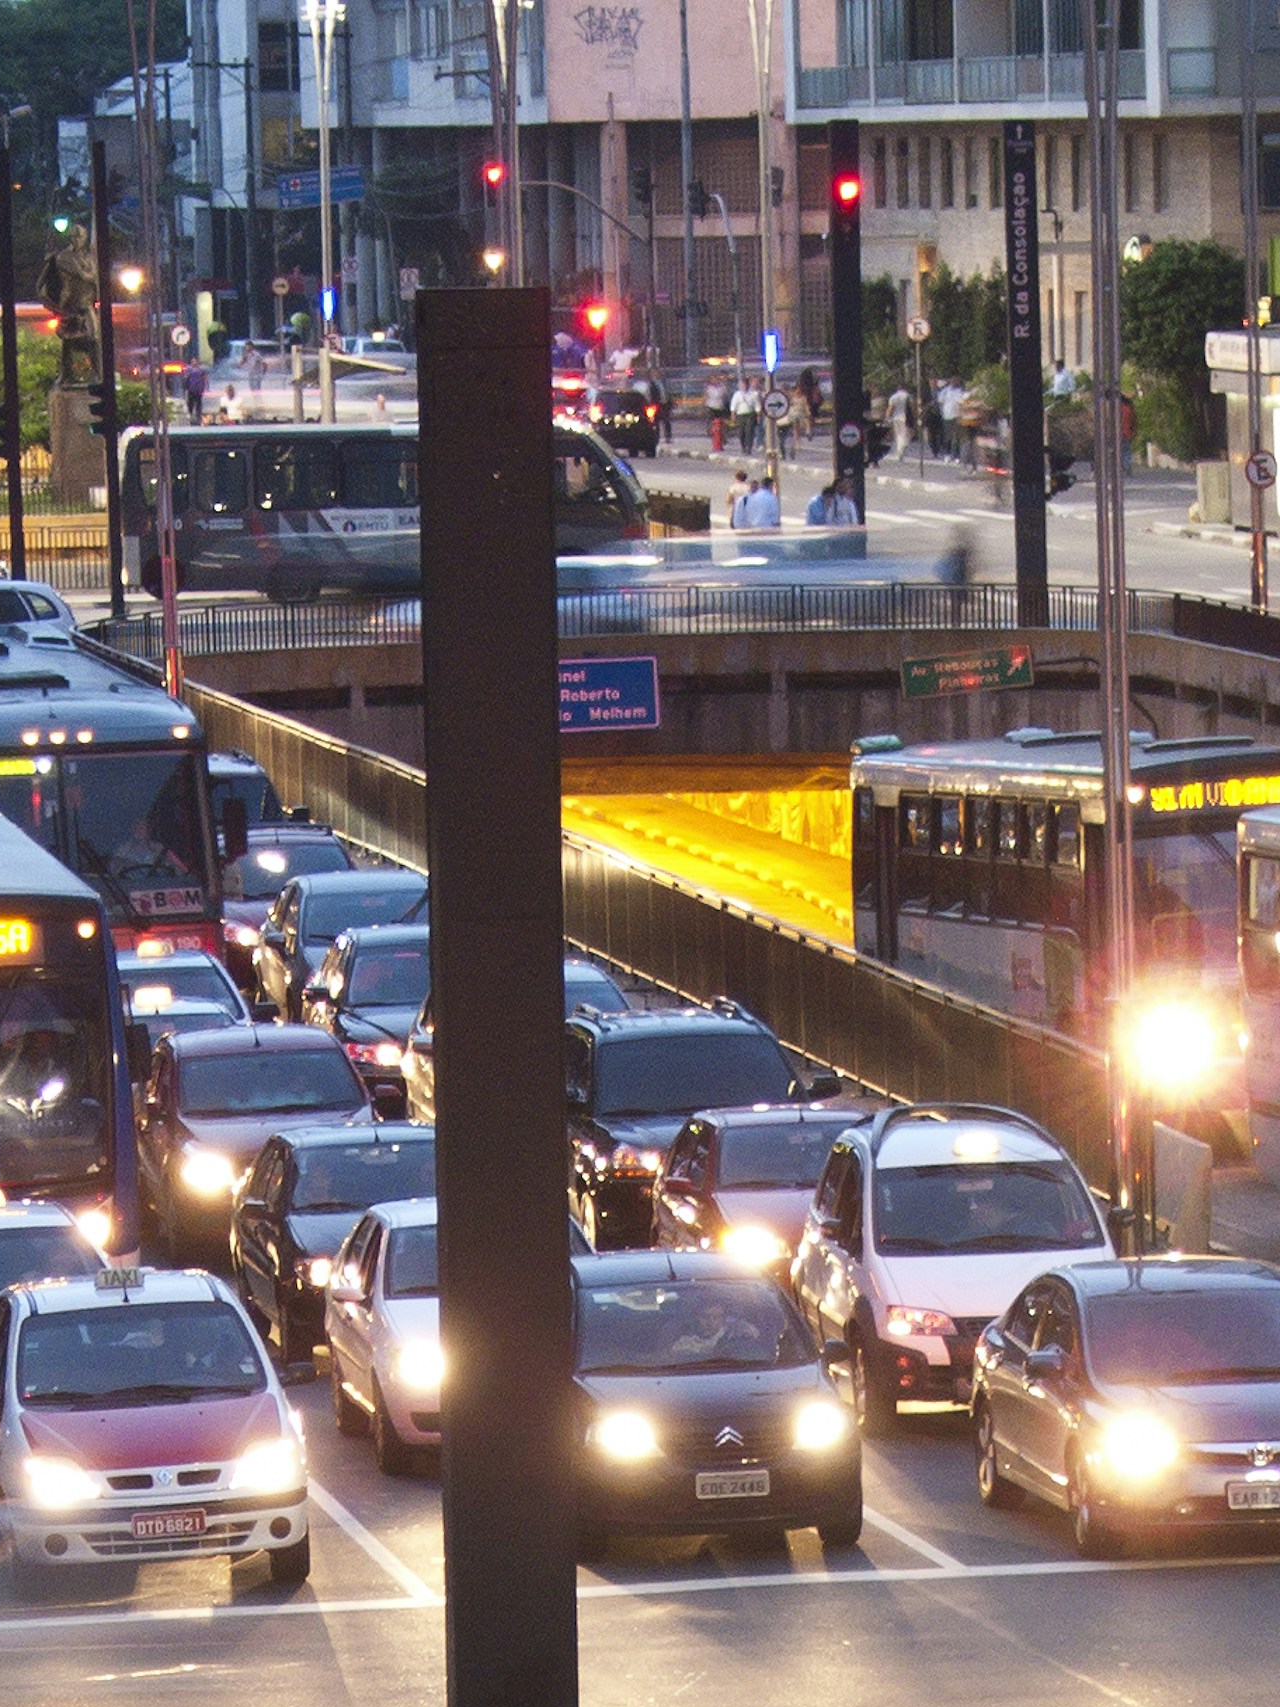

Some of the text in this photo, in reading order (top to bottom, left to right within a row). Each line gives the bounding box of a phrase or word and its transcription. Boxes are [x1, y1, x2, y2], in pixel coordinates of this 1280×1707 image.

[1014, 290, 1030, 315] da
[560, 687, 620, 703] Roberto
[588, 706, 647, 721] Melhem
[102, 1268, 138, 1286] TAXI
